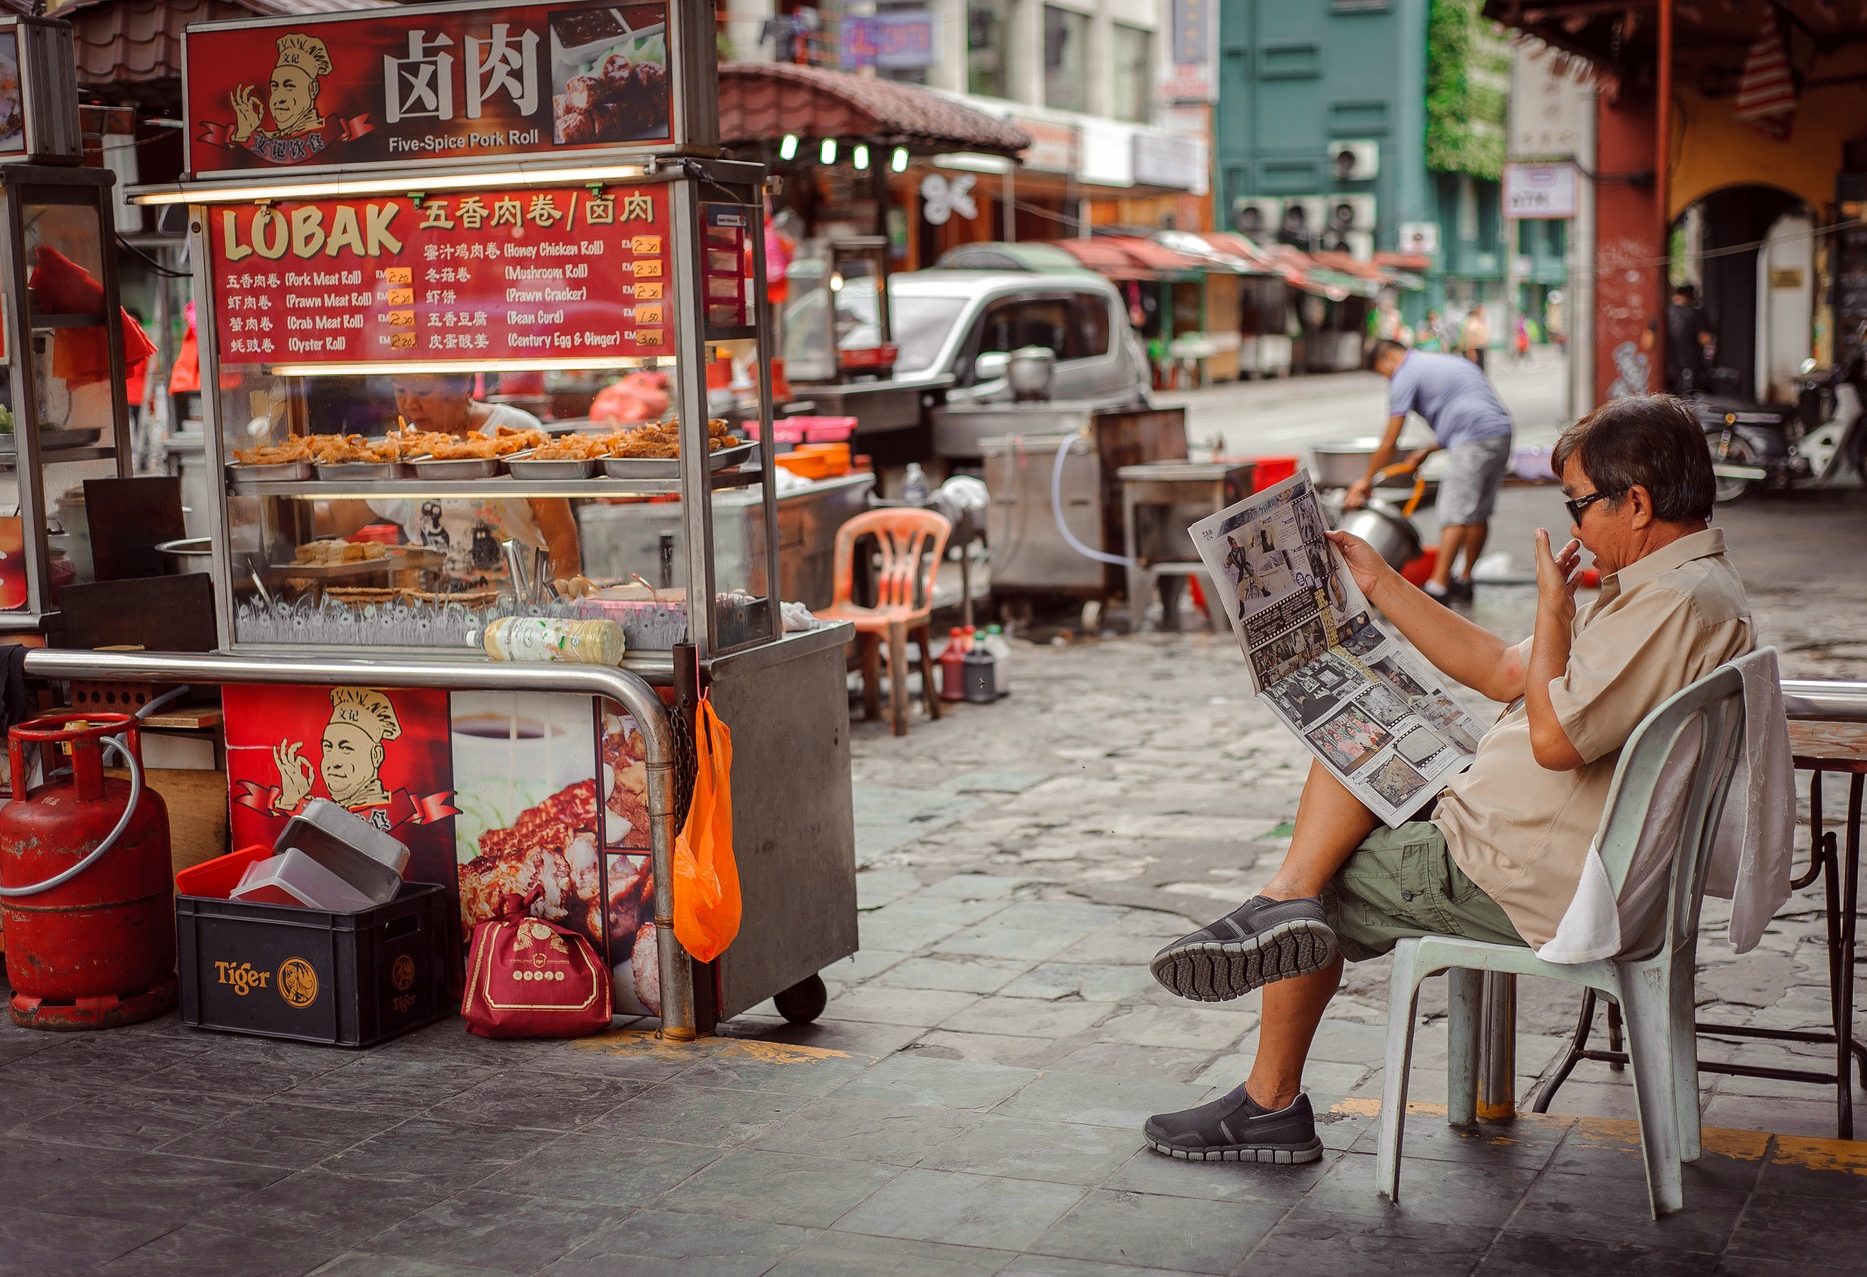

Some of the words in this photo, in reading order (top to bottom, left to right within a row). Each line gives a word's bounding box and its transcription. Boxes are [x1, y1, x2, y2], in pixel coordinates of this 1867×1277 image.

[283, 52, 300, 64] 文记
[384, 24, 540, 123] 卤肉
[254, 132, 325, 159] 文记饮食
[389, 134, 465, 152] Five-Spice
[469, 131, 504, 147] Pork
[509, 129, 538, 145] Roll
[419, 191, 654, 231] 五香肉卷/卤肉
[222, 202, 403, 261] LOBAK
[423, 242, 500, 260] 蜜汁鸡肉卷
[504, 243, 537, 259] (Honey
[539, 241, 578, 257] Chicken
[581, 240, 604, 256] Roll)
[226, 273, 281, 289] 五香肉卷
[285, 272, 311, 287] (Pork
[312, 271, 339, 286] Meat
[341, 270, 362, 285] Roll)
[425, 266, 471, 283] 冬菇卷
[505, 265, 564, 280] (Mushroom
[566, 264, 588, 278] Roll)
[227, 295, 272, 310] 虾肉卷
[286, 294, 322, 308] (Prawn
[324, 293, 350, 307] Meat
[351, 292, 372, 306] Roll)
[426, 289, 456, 305] 虾饼
[505, 288, 542, 302] (Prawn
[544, 286, 586, 301] Cracker)
[229, 317, 274, 332] 蟹肉卷
[287, 316, 313, 330] (Crab
[315, 315, 341, 329] Meat
[343, 314, 364, 329] Roll)
[377, 314, 389, 323] RM
[427, 311, 488, 327] 五香豆腐
[507, 311, 535, 326] (Bean
[537, 309, 564, 324] Curd)
[623, 307, 636, 317] RM
[288, 337, 324, 354] (Oyster
[325, 336, 346, 350] Roll)
[379, 336, 391, 345] RM
[429, 333, 489, 350] 皮蛋酸姜
[508, 333, 551, 349] (Century
[553, 332, 572, 347] Egg
[574, 331, 582, 346] &
[584, 331, 621, 347] Ginger)
[624, 330, 637, 340] RM
[339, 707, 359, 722] 文记
[214, 960, 270, 996] Tiger
[393, 993, 416, 1013] Tiger
